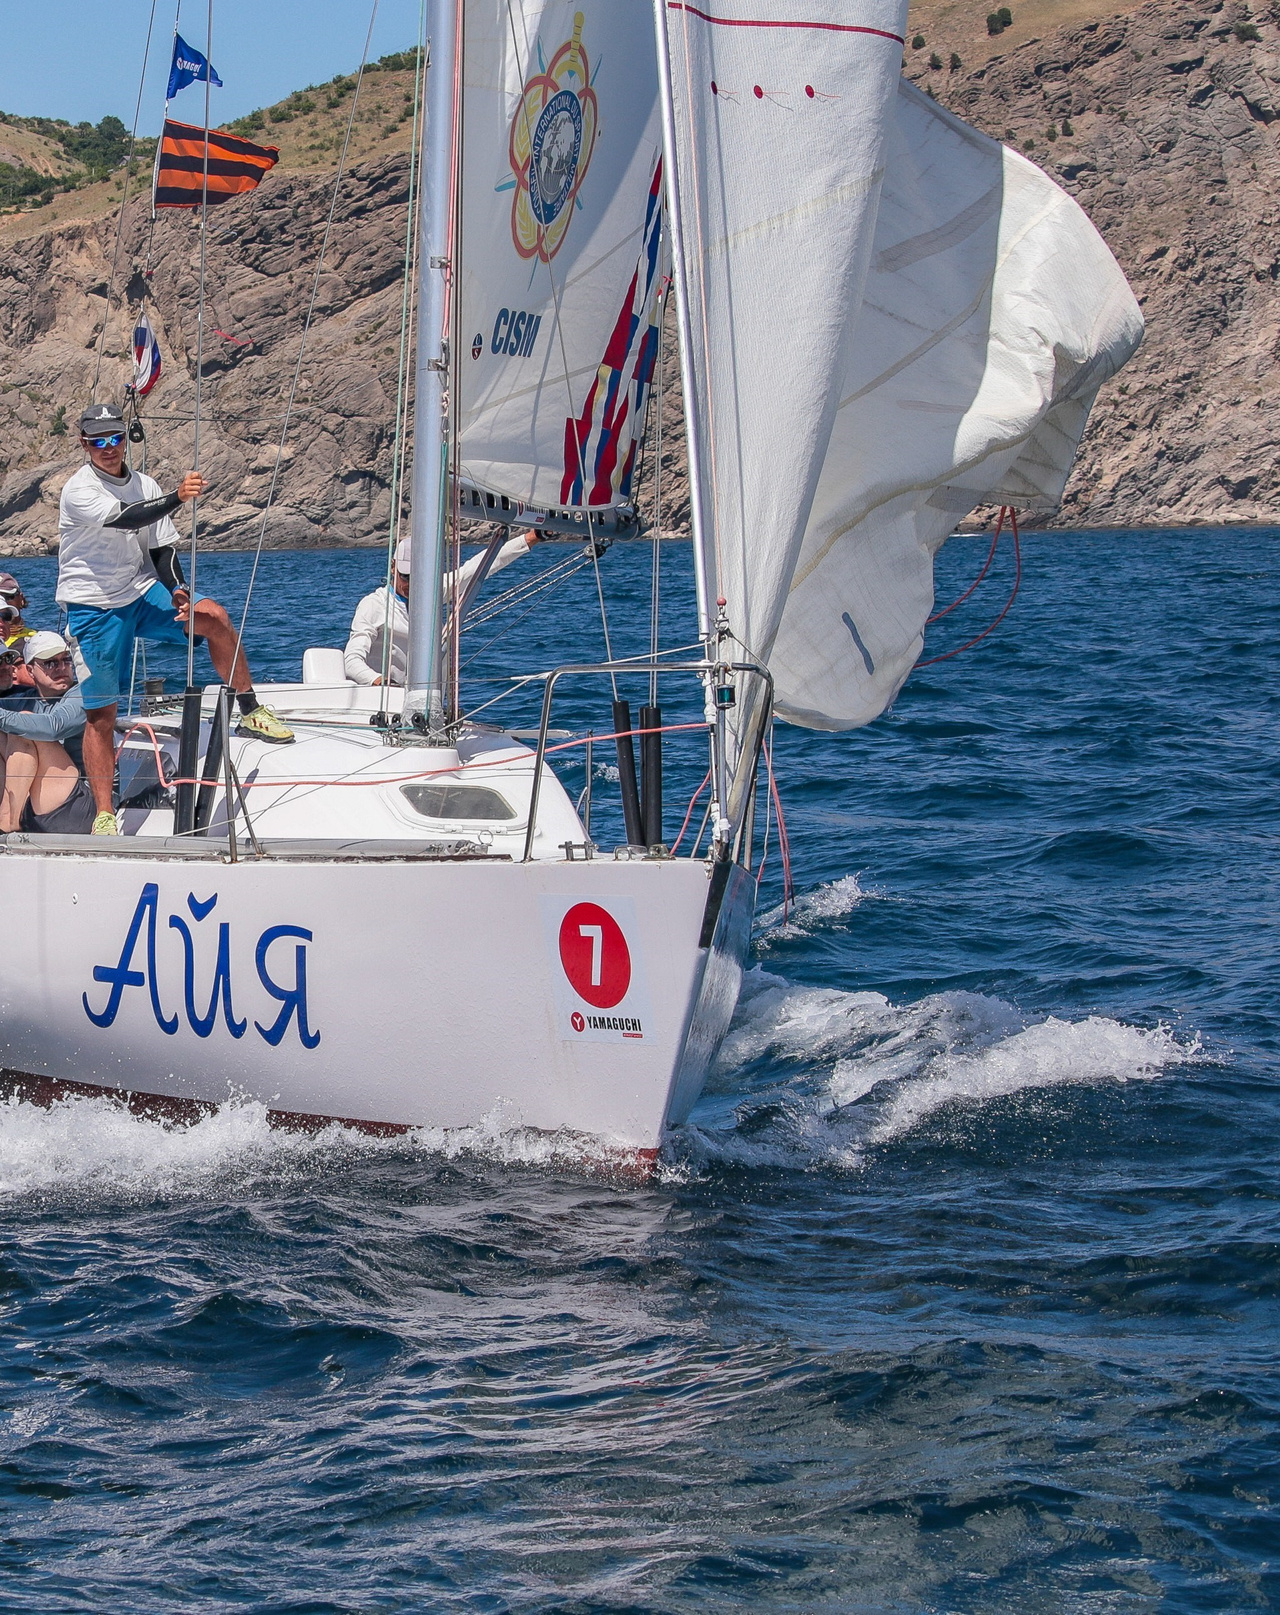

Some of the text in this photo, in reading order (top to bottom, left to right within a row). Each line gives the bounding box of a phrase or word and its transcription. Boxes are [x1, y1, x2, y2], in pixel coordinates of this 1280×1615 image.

[533, 94, 572, 160] INTERNATIONAL
[570, 100, 579, 119] DU
[573, 115, 582, 159] SPORT
[491, 307, 542, 358] CISM
[82, 882, 321, 1050] Айя
[578, 923, 603, 987] 7
[586, 1015, 642, 1032] YAMAGUCHI
